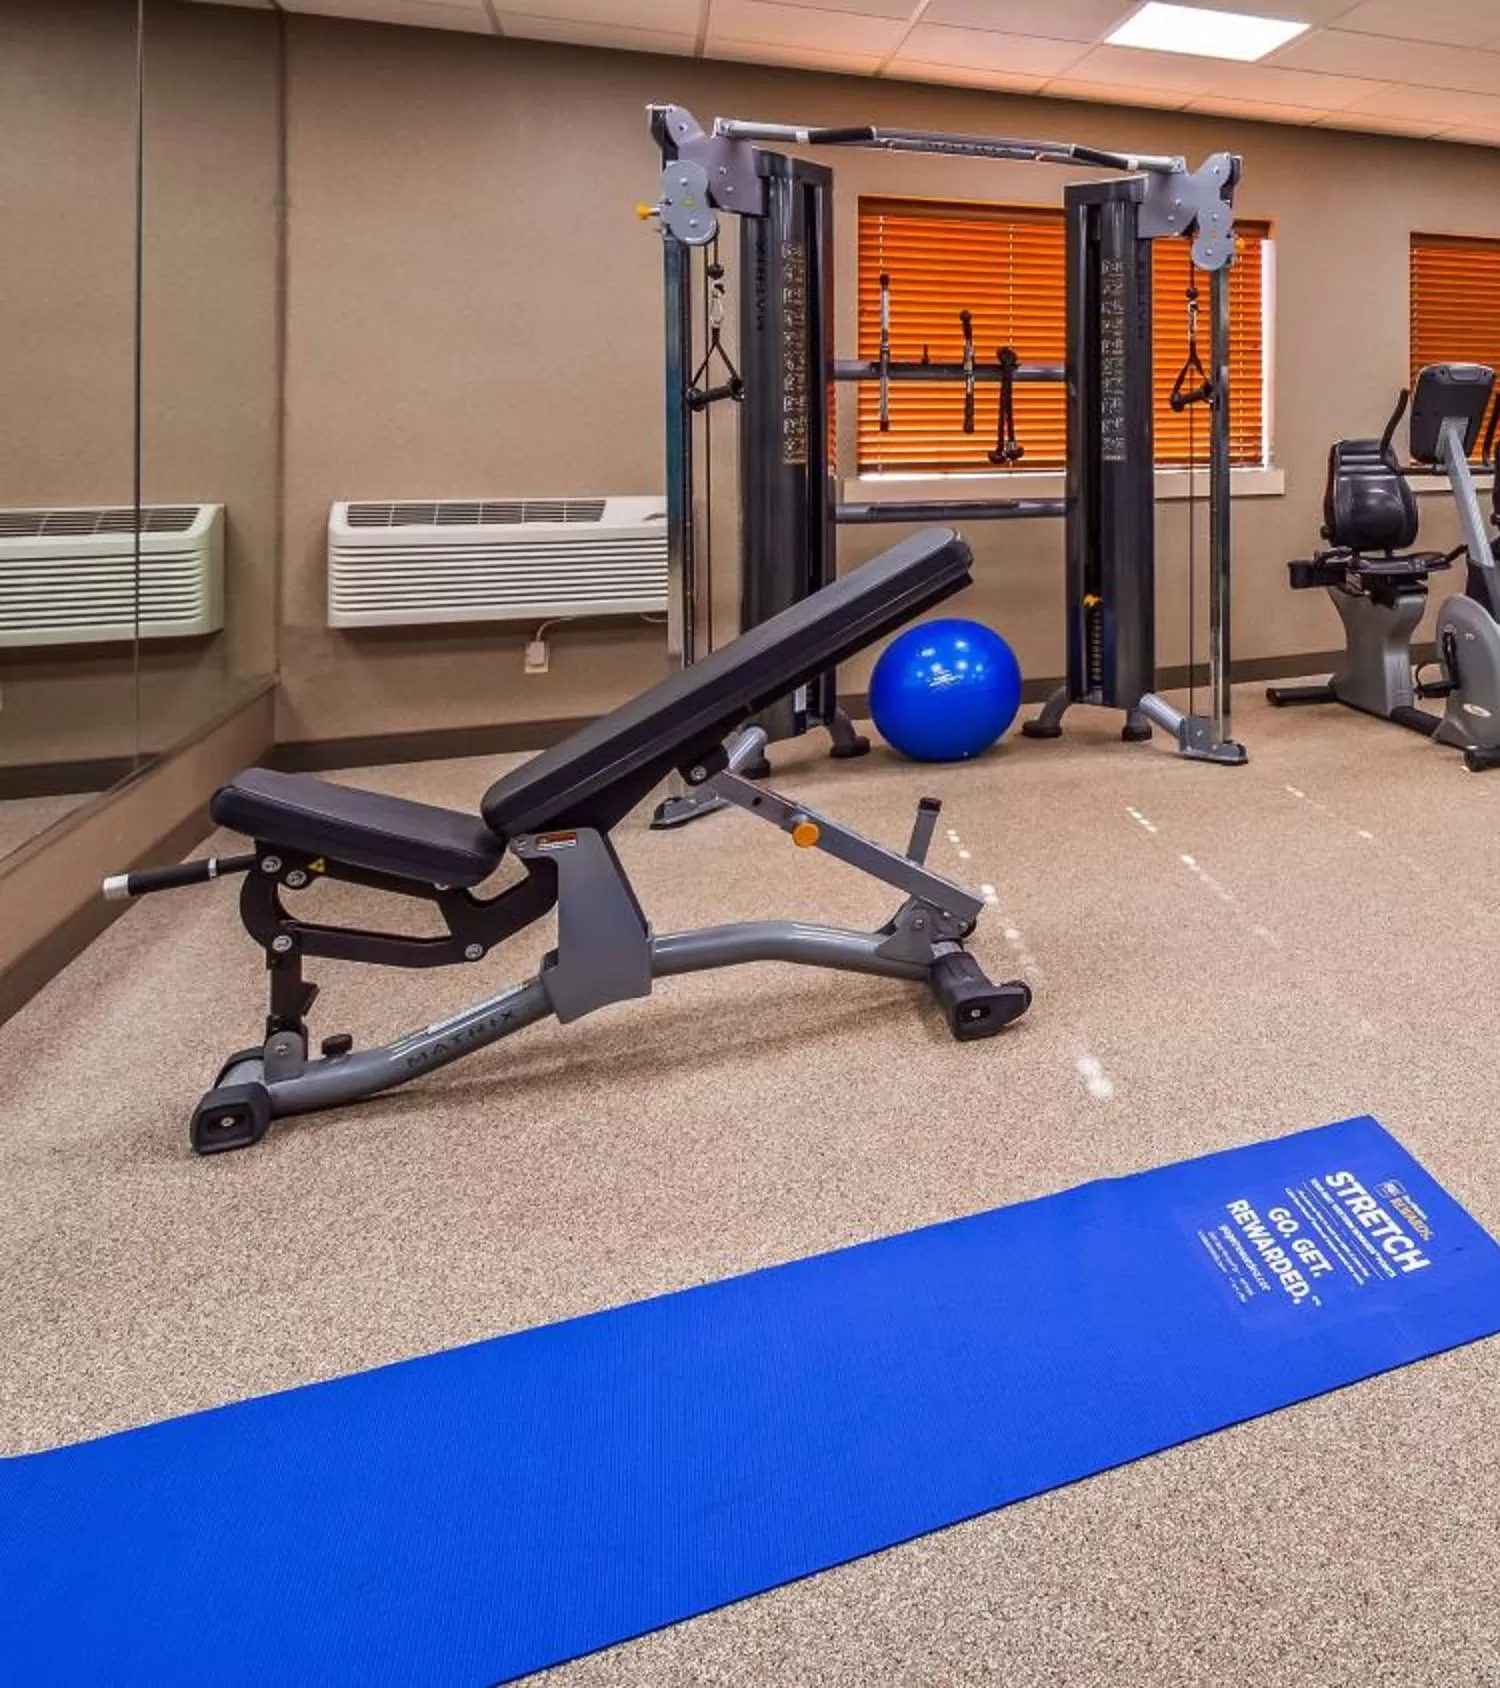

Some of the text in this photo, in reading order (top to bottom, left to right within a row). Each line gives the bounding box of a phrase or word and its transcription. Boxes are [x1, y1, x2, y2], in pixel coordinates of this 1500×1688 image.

[407, 1009, 513, 1069] MATRIX
[1226, 1199, 1311, 1305] REWARDED.
[1268, 1207, 1299, 1239] GO.
[1291, 1238, 1334, 1278] GET.
[1325, 1171, 1432, 1273] STRETCH
